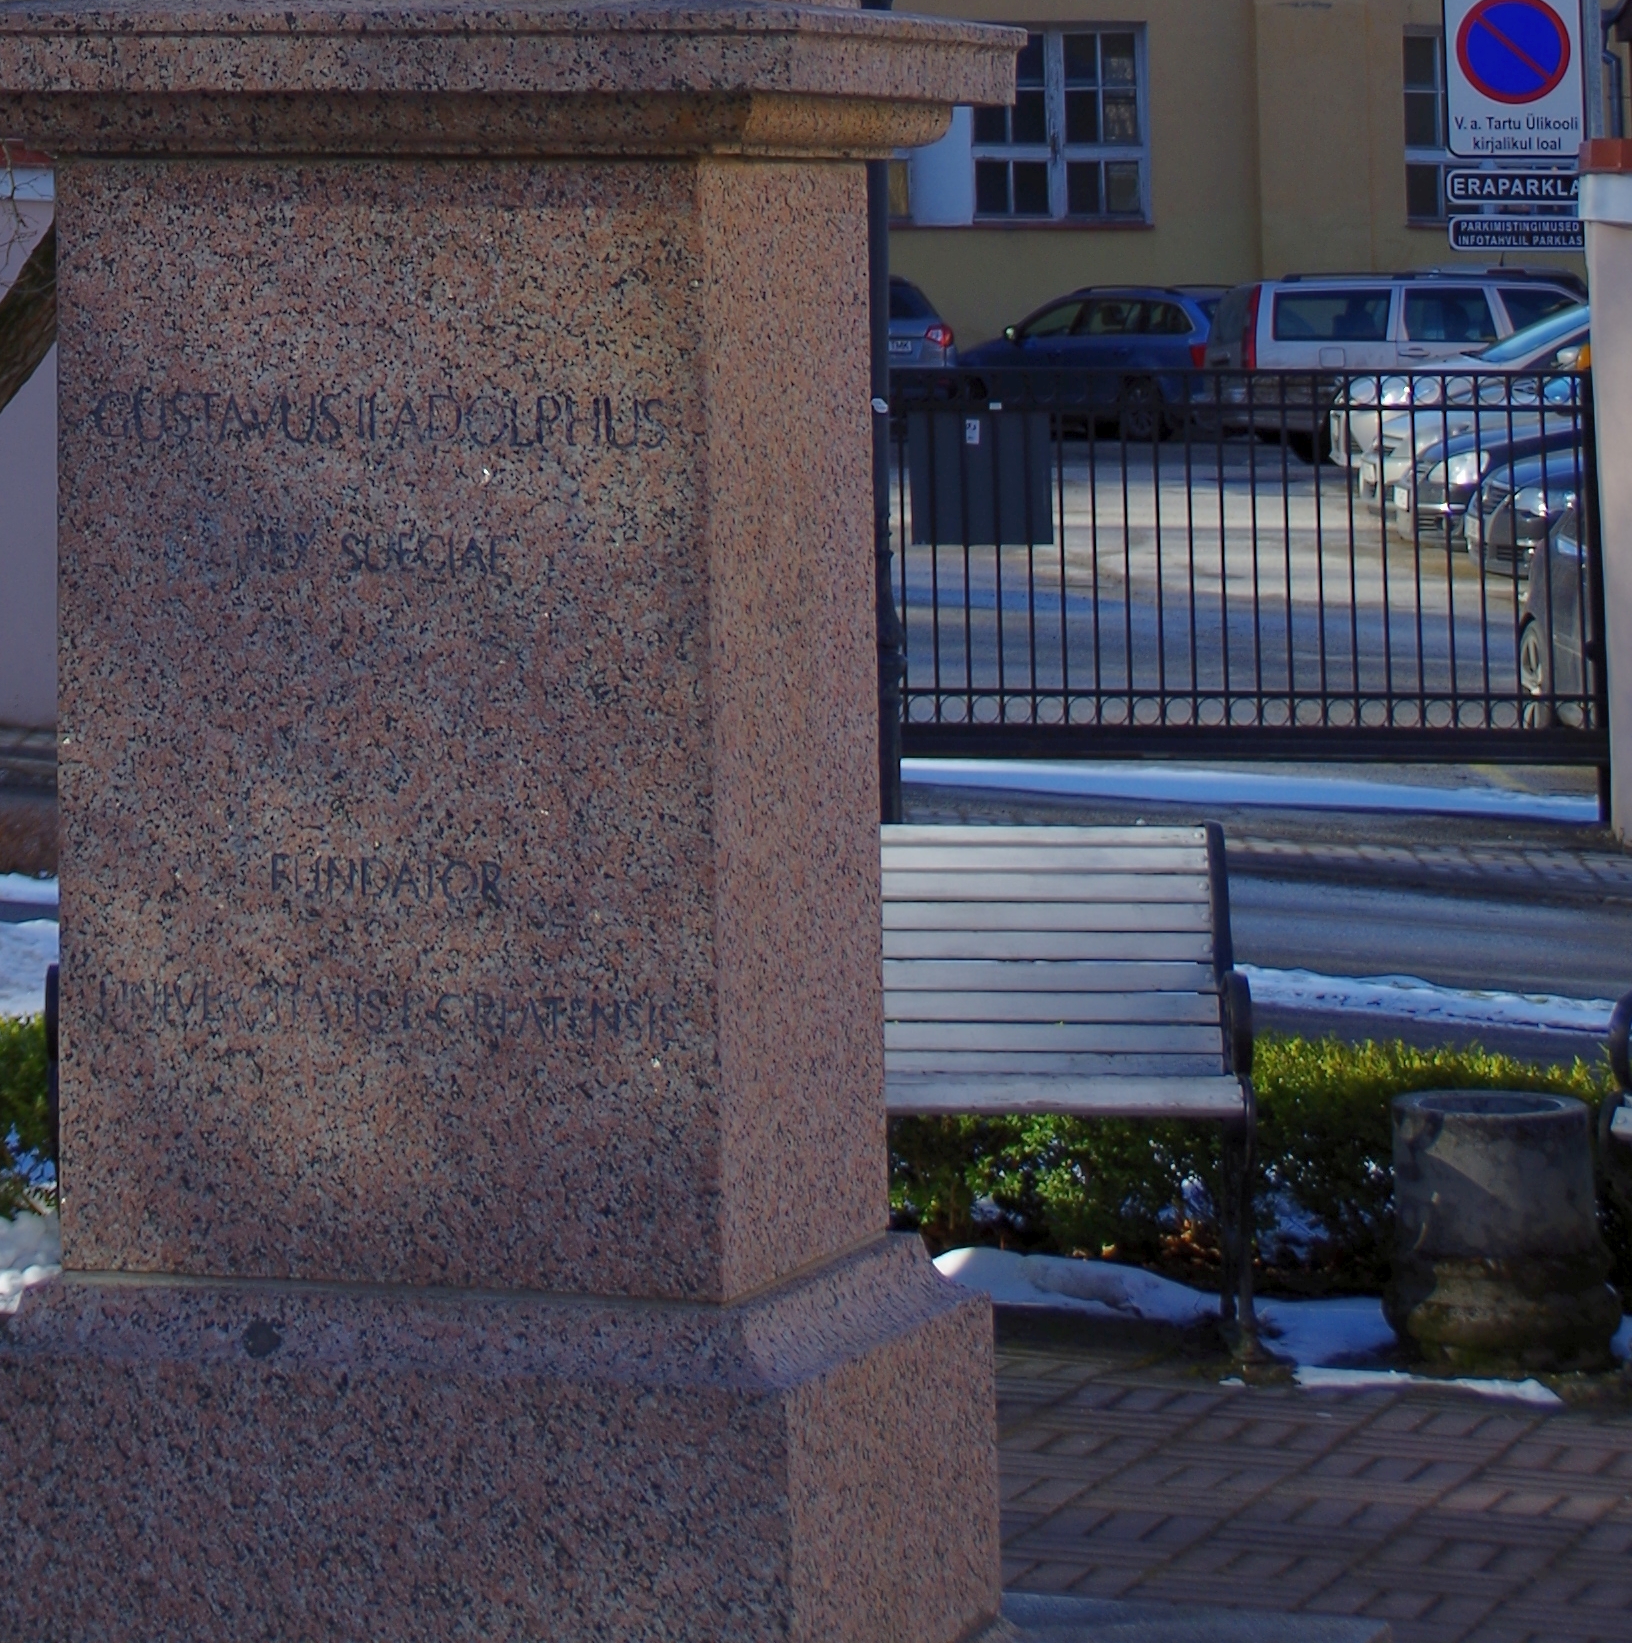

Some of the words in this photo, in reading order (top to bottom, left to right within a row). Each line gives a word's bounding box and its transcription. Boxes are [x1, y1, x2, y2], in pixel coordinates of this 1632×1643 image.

[1454, 116, 1467, 130] V.
[1470, 119, 1481, 130] a.
[1486, 116, 1521, 130] Tartu
[1526, 112, 1579, 130] Ülikooli
[1473, 136, 1533, 154] kirjalikul
[1536, 136, 1561, 150] loal
[1460, 221, 1580, 233] PARKIMISTINGIMUSED
[1458, 235, 1529, 246] INFOTAHVLIL
[1532, 235, 1583, 246] PARKLAS
[95, 388, 343, 445] GUSTAVUS
[356, 392, 376, 443] II
[391, 391, 666, 449] ADOLPHUS
[270, 852, 506, 906] FUNDATOR
